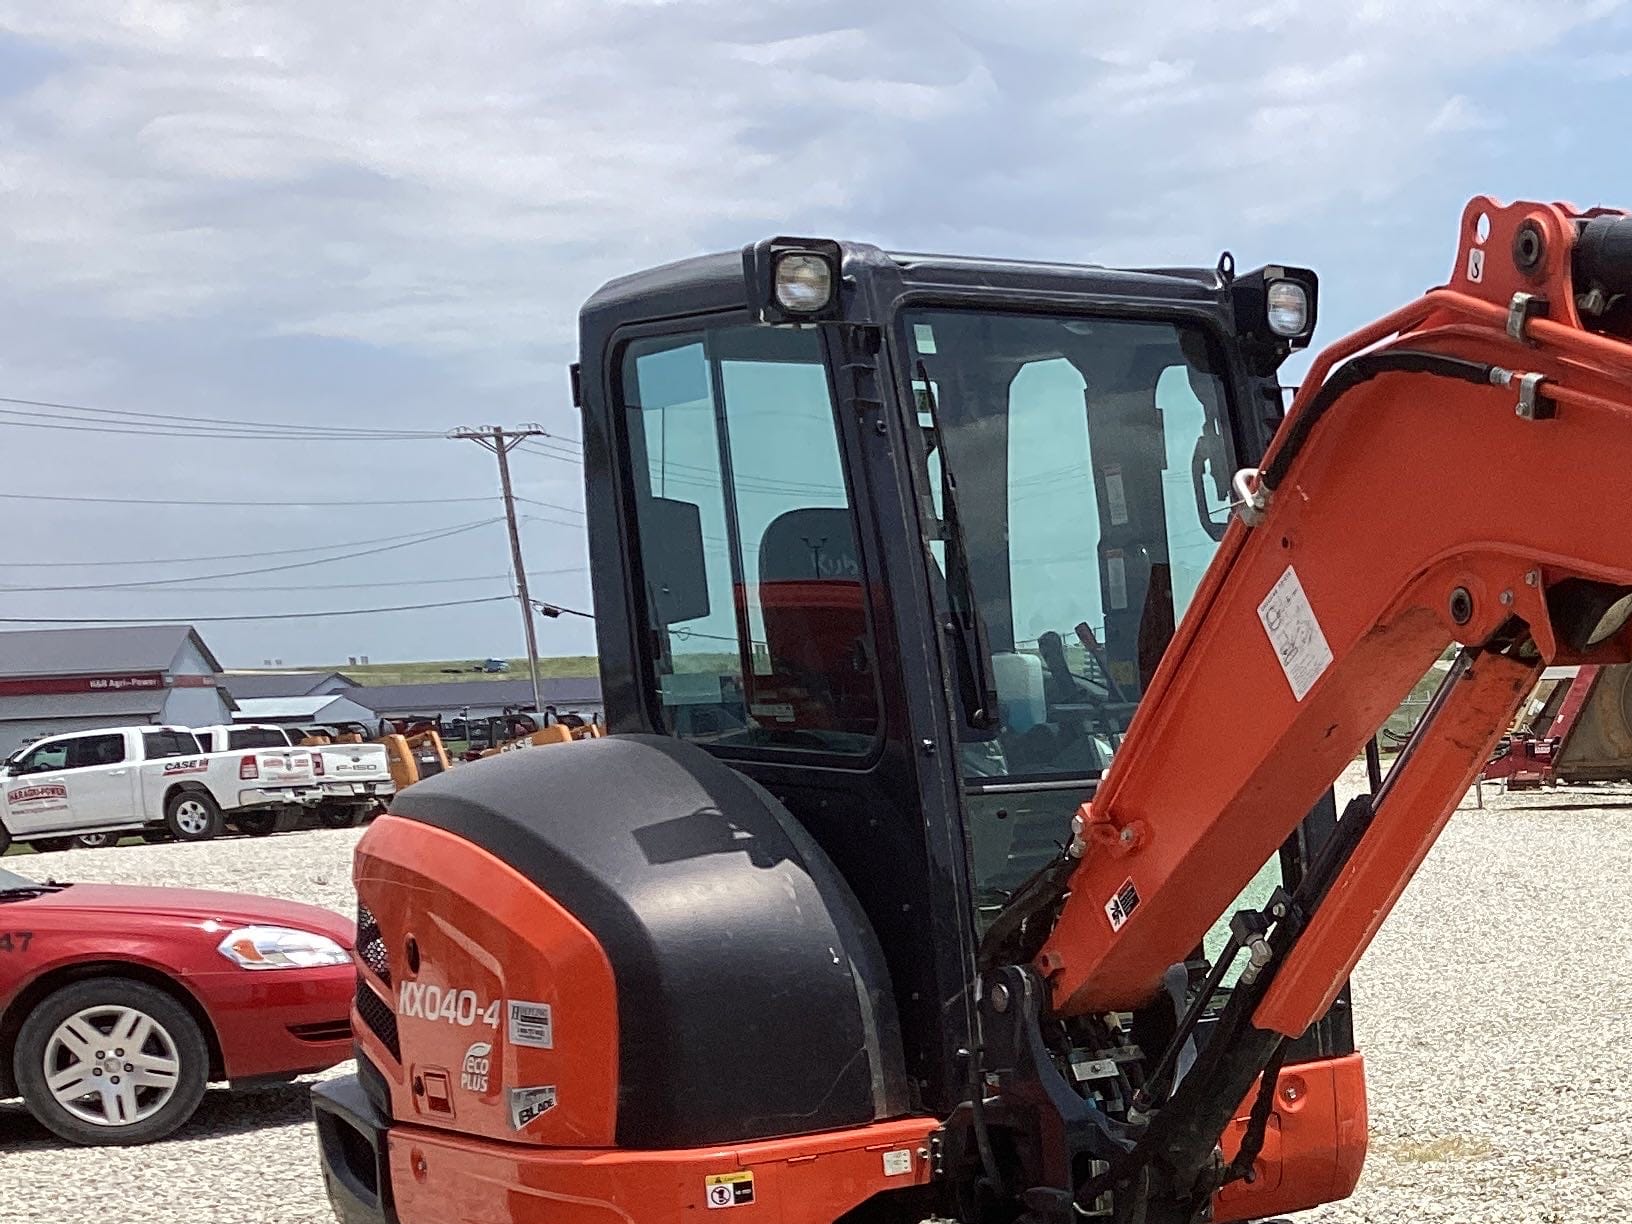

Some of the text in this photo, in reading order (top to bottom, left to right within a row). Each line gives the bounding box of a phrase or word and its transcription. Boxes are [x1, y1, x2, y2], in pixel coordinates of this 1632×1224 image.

[164, 759, 198, 771] CASE
[336, 764, 377, 772] F-150
[399, 981, 501, 1029] KX040-4
[466, 1055, 490, 1075] eco
[461, 1072, 489, 1093] PLUS
